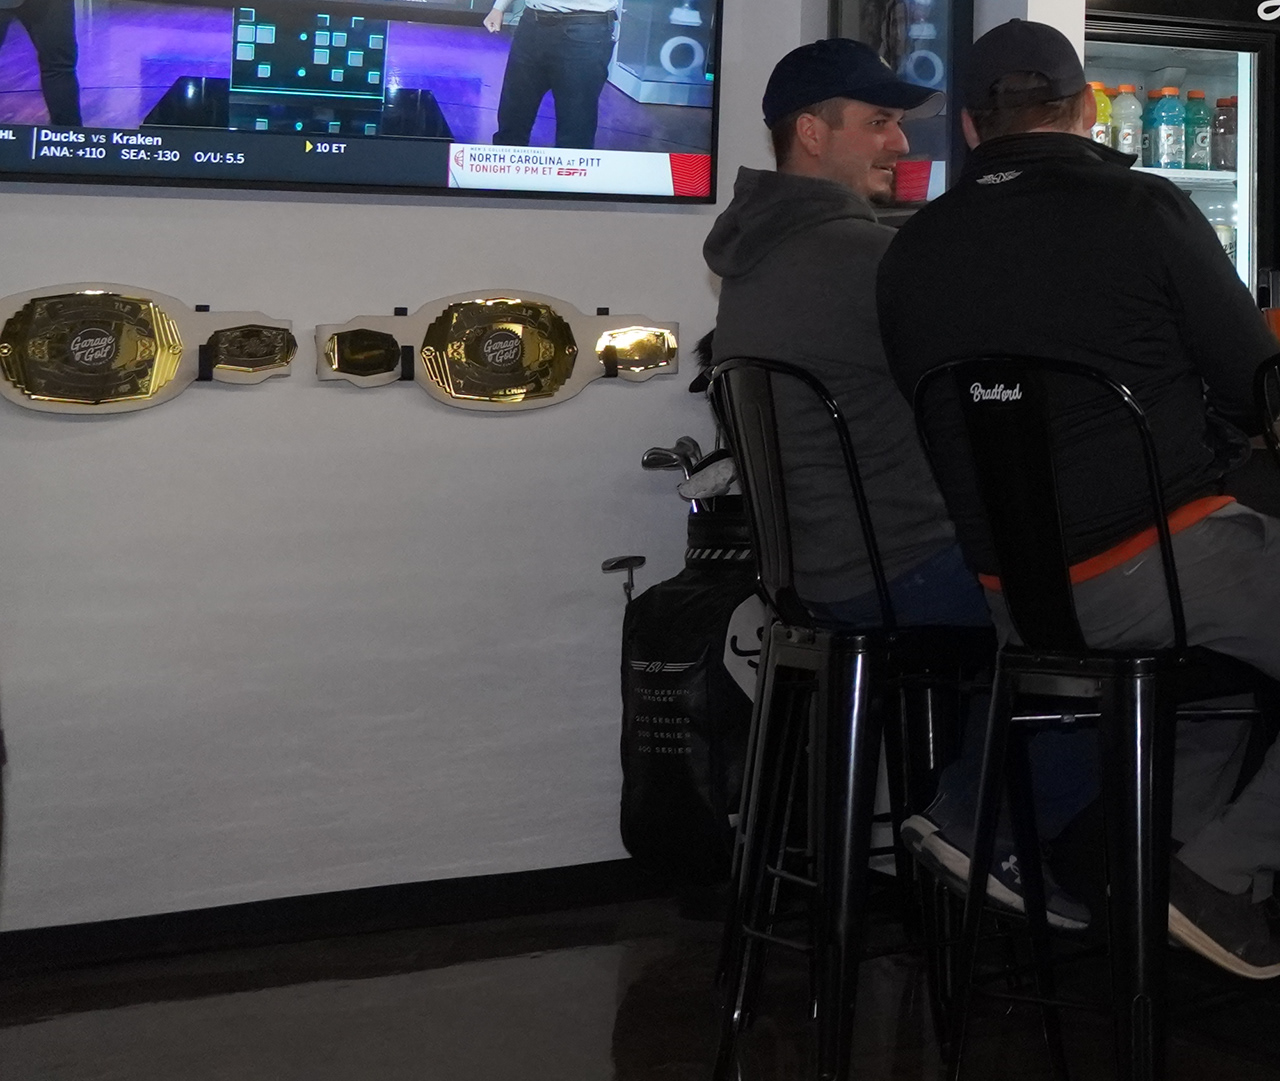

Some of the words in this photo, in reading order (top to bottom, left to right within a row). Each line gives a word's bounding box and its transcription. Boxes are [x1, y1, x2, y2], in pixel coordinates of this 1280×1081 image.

[41, 130, 85, 143] Ducks
[92, 133, 106, 142] vs
[112, 132, 162, 146] Kraken
[316, 142, 328, 153] 10
[332, 143, 346, 153] ET
[40, 147, 73, 157] ANA:
[76, 147, 106, 158] +110
[121, 149, 150, 160] SEA:
[154, 150, 179, 161] -130
[194, 151, 223, 163] O/U:
[226, 152, 245, 163] 5.5
[470, 153, 505, 163] NORTH
[510, 155, 562, 165] CAROLINA
[579, 158, 601, 167] PITT
[470, 164, 511, 173] TONIGHT
[525, 166, 538, 174] PM
[557, 168, 587, 176] ESPN
[71, 335, 115, 350] Garage
[484, 338, 520, 352] Garage
[84, 348, 111, 361] Golf
[496, 349, 517, 363] Golf
[970, 382, 1022, 402] Bradford
